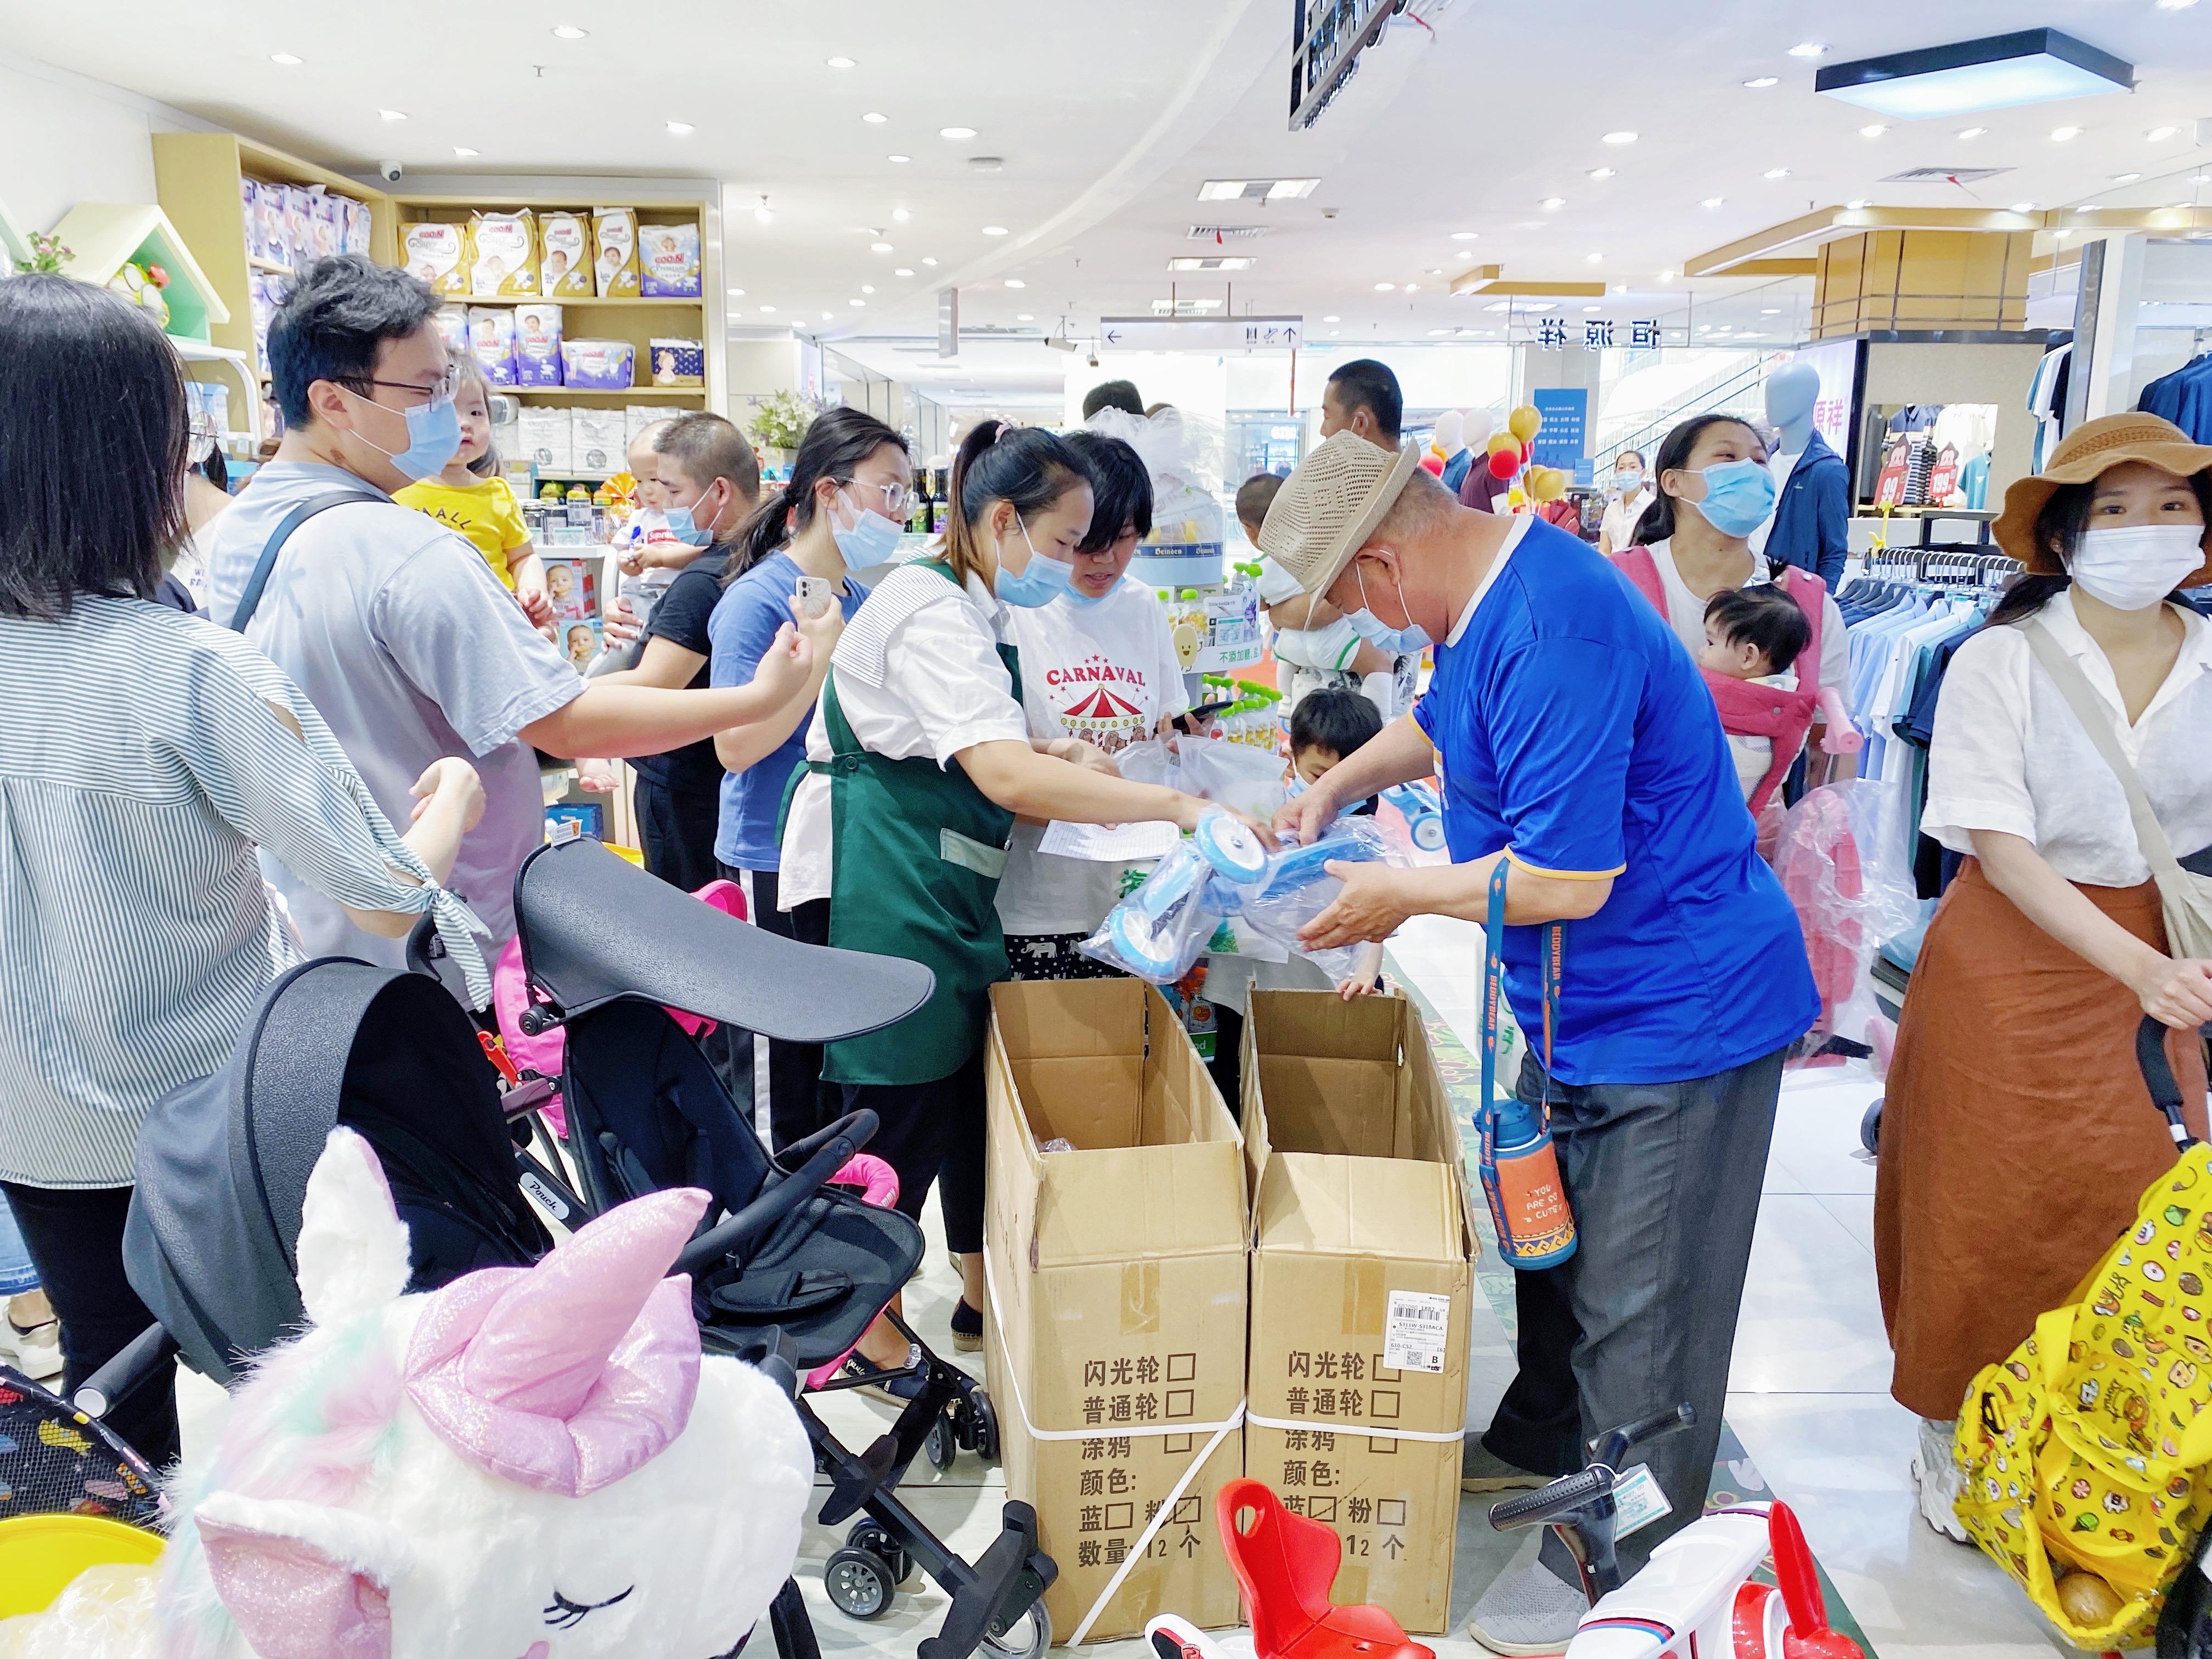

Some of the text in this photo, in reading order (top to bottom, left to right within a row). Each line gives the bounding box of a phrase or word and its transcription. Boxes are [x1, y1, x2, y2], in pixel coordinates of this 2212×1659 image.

[1933, 473, 1950, 493] 199
[1047, 665, 1146, 686] CARNAVAL
[529, 1181, 556, 1211] Pouch
[1527, 1192, 1558, 1211] ARE SO
[1534, 1184, 1551, 1195] YOU
[1084, 1356, 1160, 1387] 闪光轮
[1288, 1350, 1365, 1380] 闪光轮
[1082, 1392, 1159, 1424] 普通轮
[1286, 1387, 1364, 1417] 普通轮
[1081, 1436, 1131, 1460] 涂鸦
[1285, 1430, 1335, 1452] 涂鸦
[1079, 1505, 1102, 1532] 蓝
[1348, 1497, 1372, 1523] 粉
[1179, 1530, 1201, 1558] 个
[1382, 1533, 1404, 1560] 个
